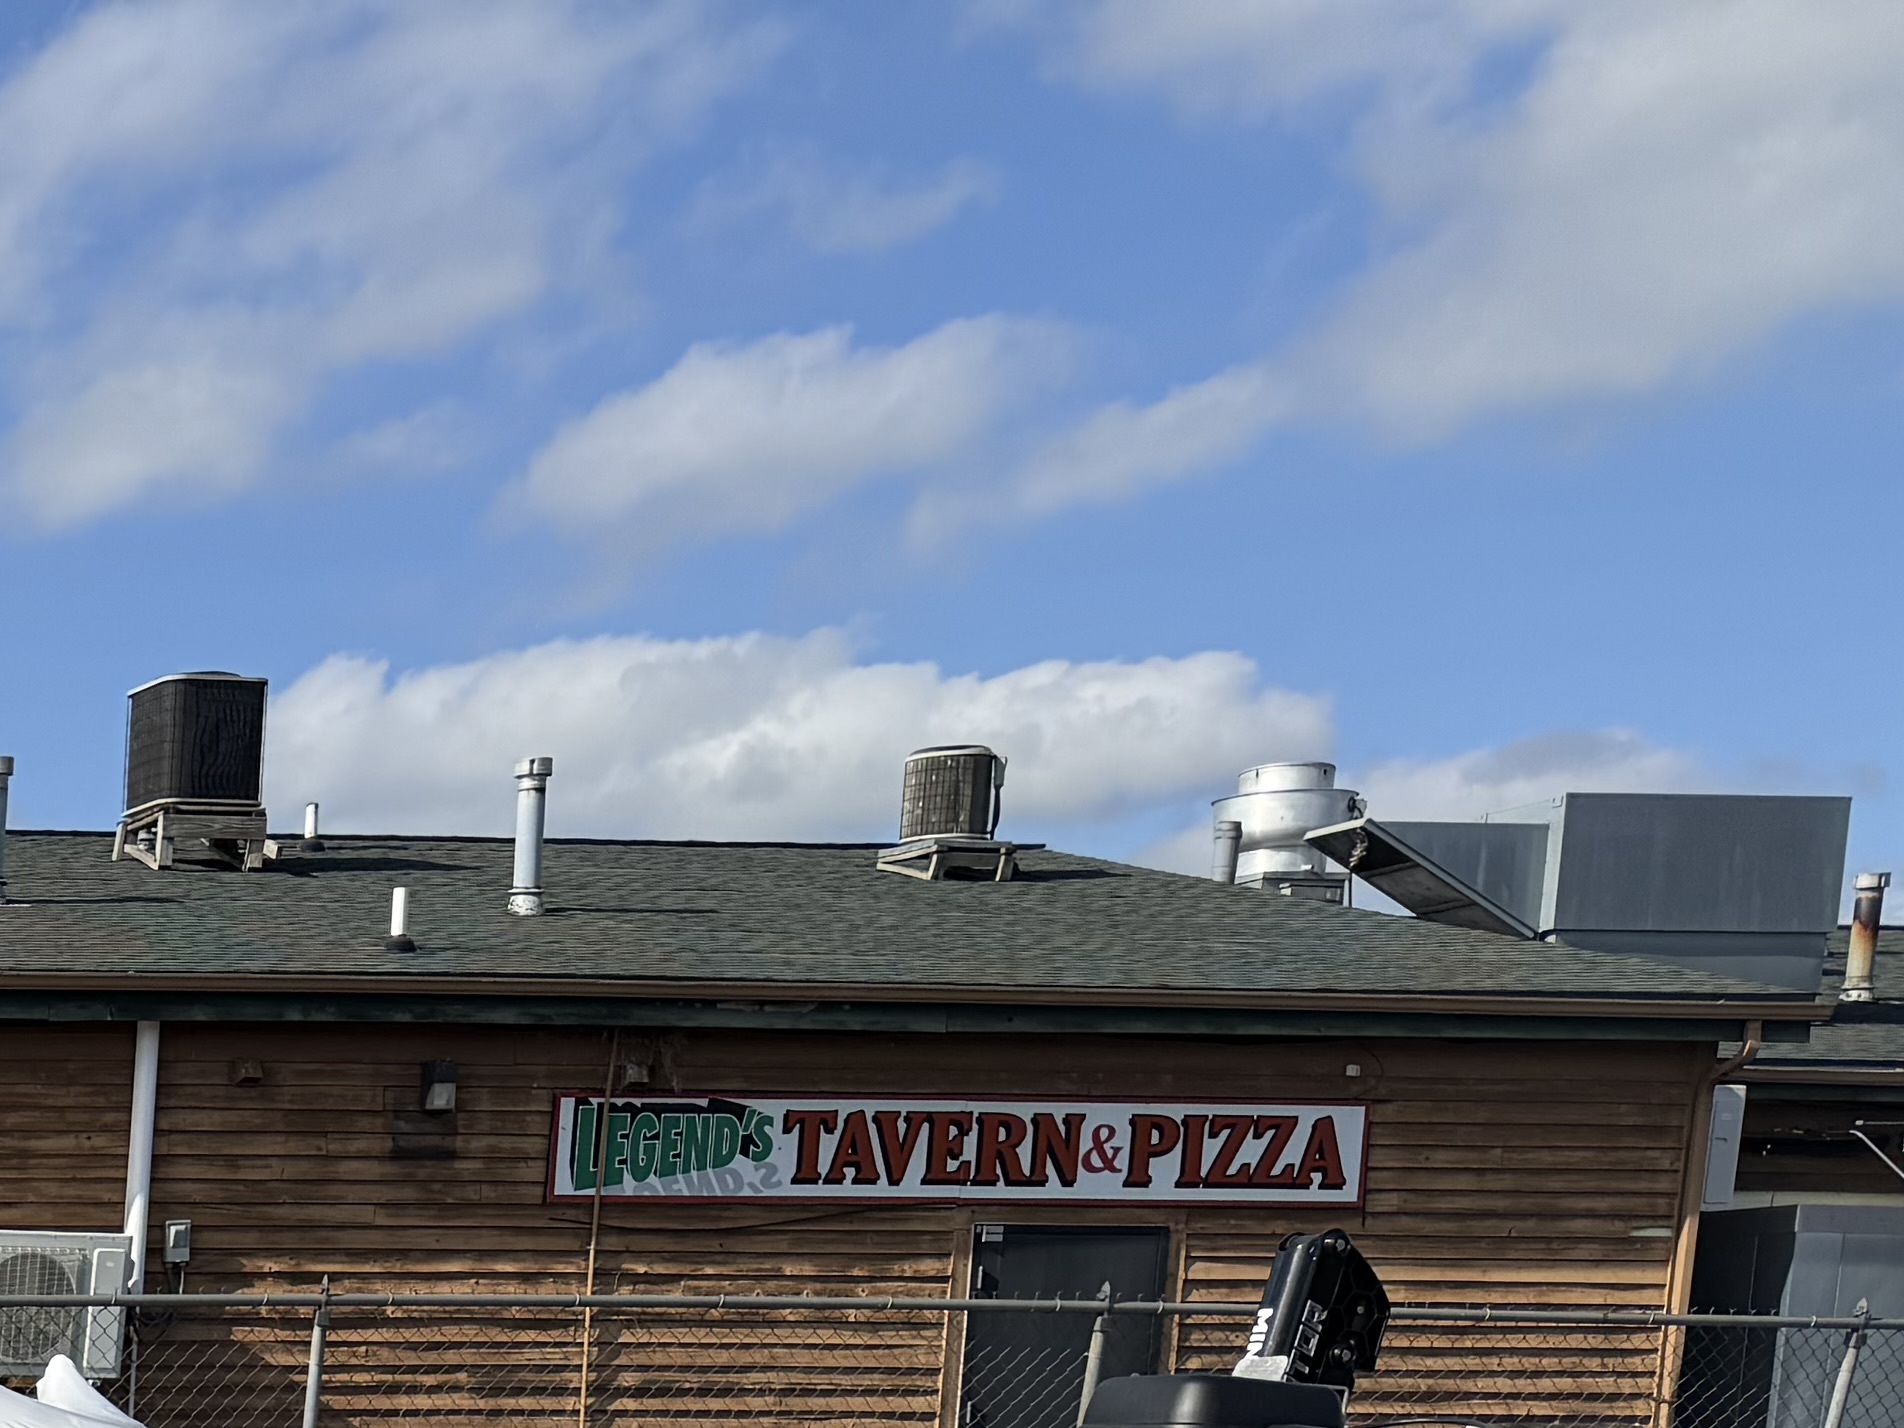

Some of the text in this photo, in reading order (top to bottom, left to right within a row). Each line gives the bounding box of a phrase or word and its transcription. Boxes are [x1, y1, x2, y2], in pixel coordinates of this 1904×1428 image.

[570, 1104, 774, 1192] LEGEND'S
[782, 1109, 1087, 1188] TAVERN
[1122, 1113, 1347, 1191] PIZZA
